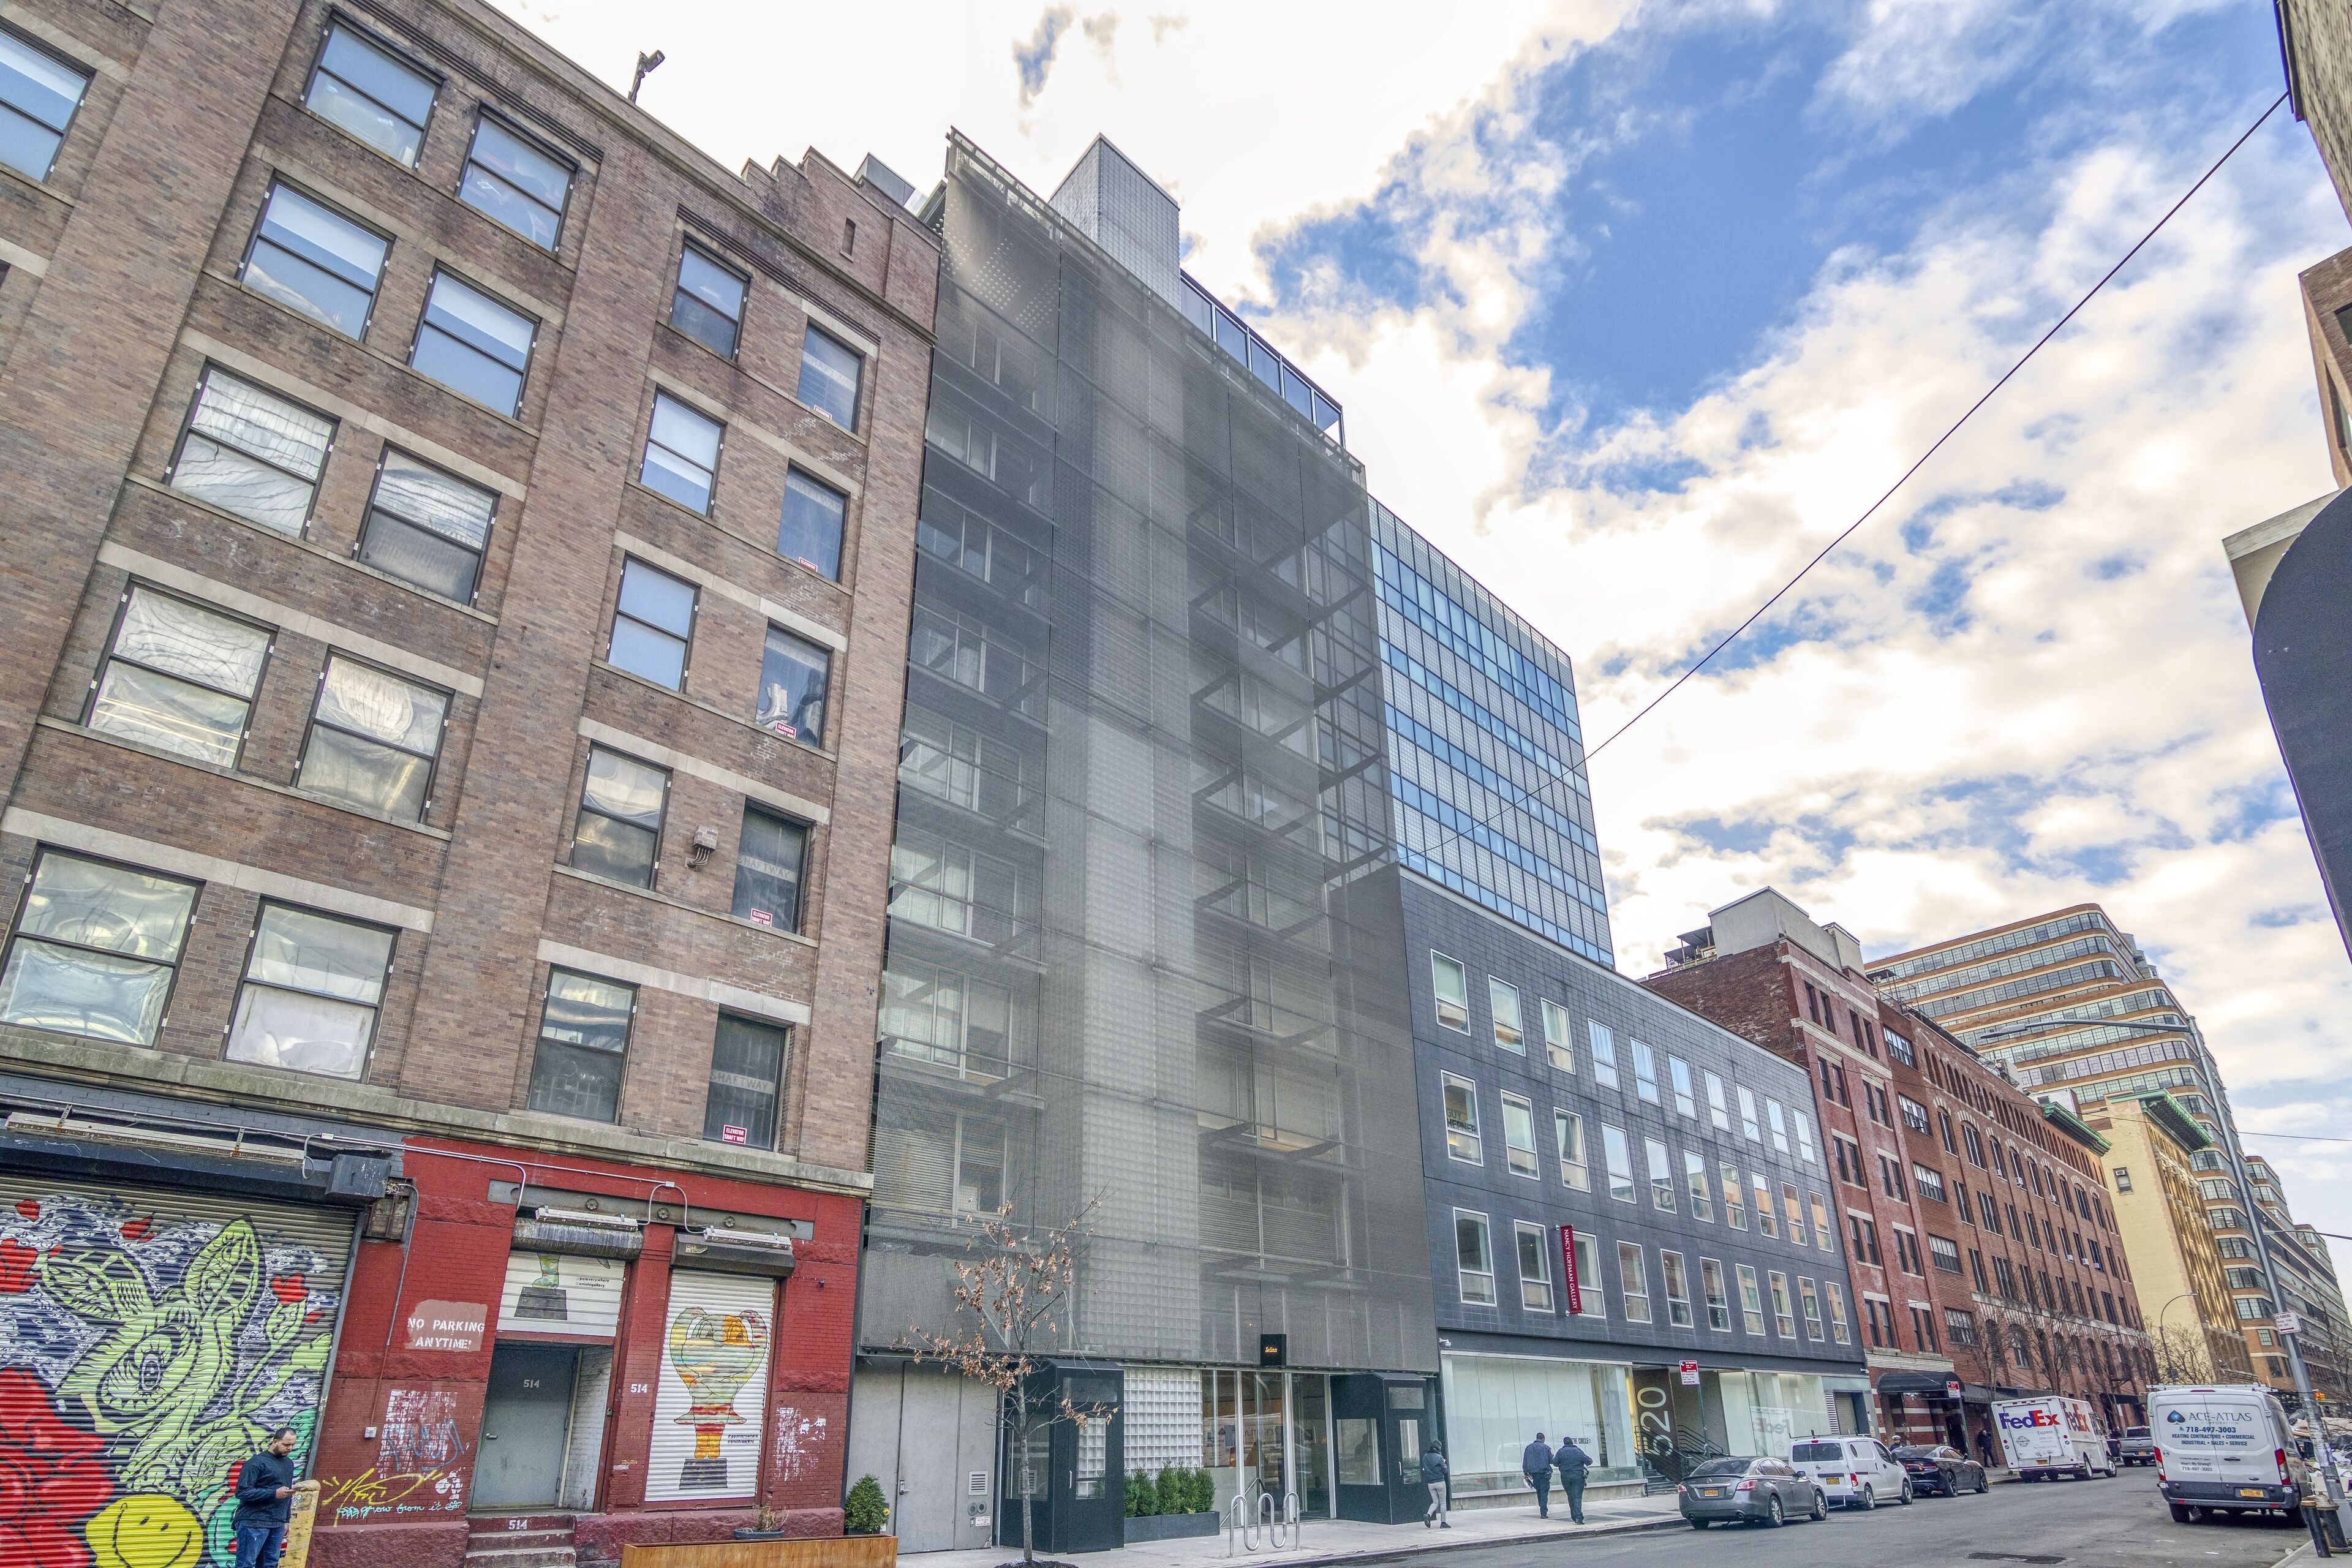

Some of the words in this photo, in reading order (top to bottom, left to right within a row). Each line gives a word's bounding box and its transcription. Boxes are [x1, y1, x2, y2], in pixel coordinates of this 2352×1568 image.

[801, 559, 816, 570] ELEVATOR
[777, 723, 794, 734] ELEVATOR
[738, 856, 790, 878] SHAFTWAY
[753, 911, 770, 919] ELEVATOR
[712, 1071, 768, 1090] SHAFTWAY
[1566, 1252, 1575, 1282] HOFFMAN
[1569, 1283, 1578, 1309] GALLERY
[407, 1317, 424, 1329] NO
[432, 1319, 485, 1332] PARKING
[523, 1379, 540, 1388] 514
[630, 1384, 647, 1393] 514
[1637, 1387, 1673, 1456] 520
[1999, 1409, 2061, 1430] FedEx
[2060, 1401, 2090, 1432] FedEx
[2189, 1412, 2252, 1421] ACE-ATLAS
[508, 1519, 527, 1530] 514
